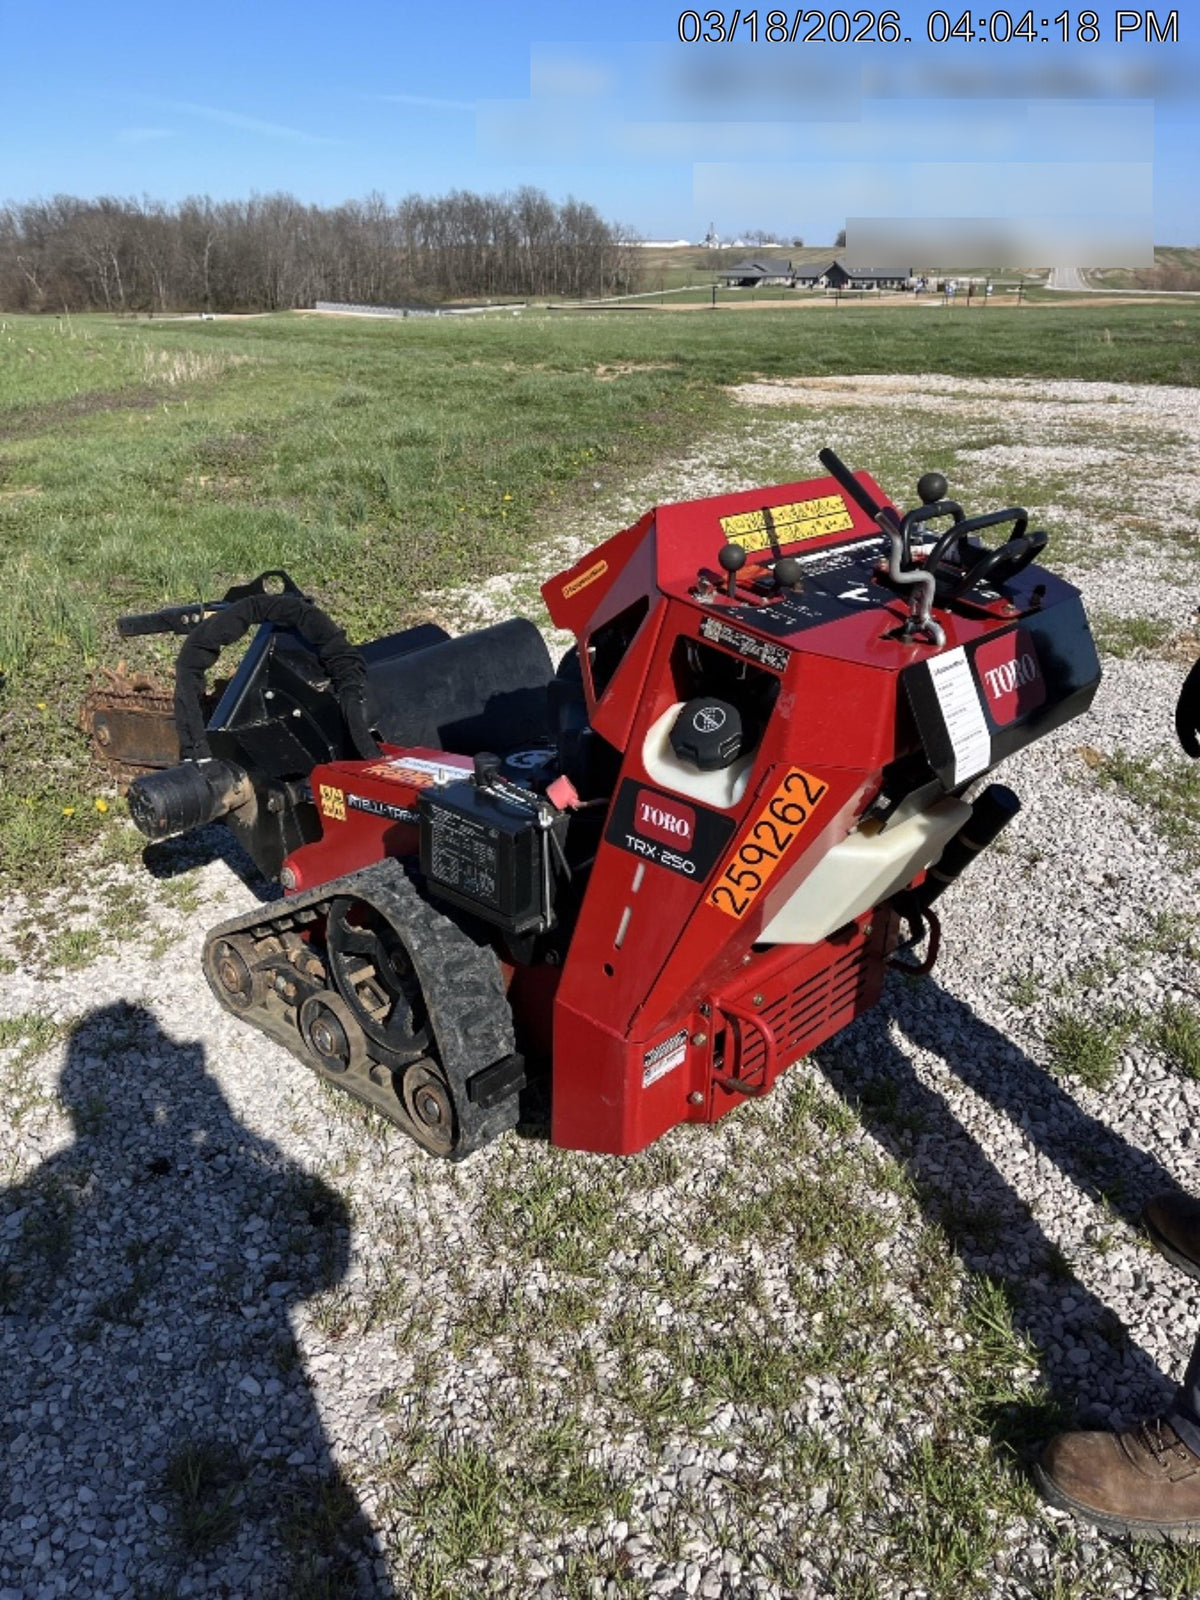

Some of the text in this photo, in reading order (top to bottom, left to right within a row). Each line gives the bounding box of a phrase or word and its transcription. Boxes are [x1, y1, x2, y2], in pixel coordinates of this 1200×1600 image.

[984, 654, 1036, 699] TORO
[641, 803, 690, 837] TORO
[711, 773, 826, 915] 259262
